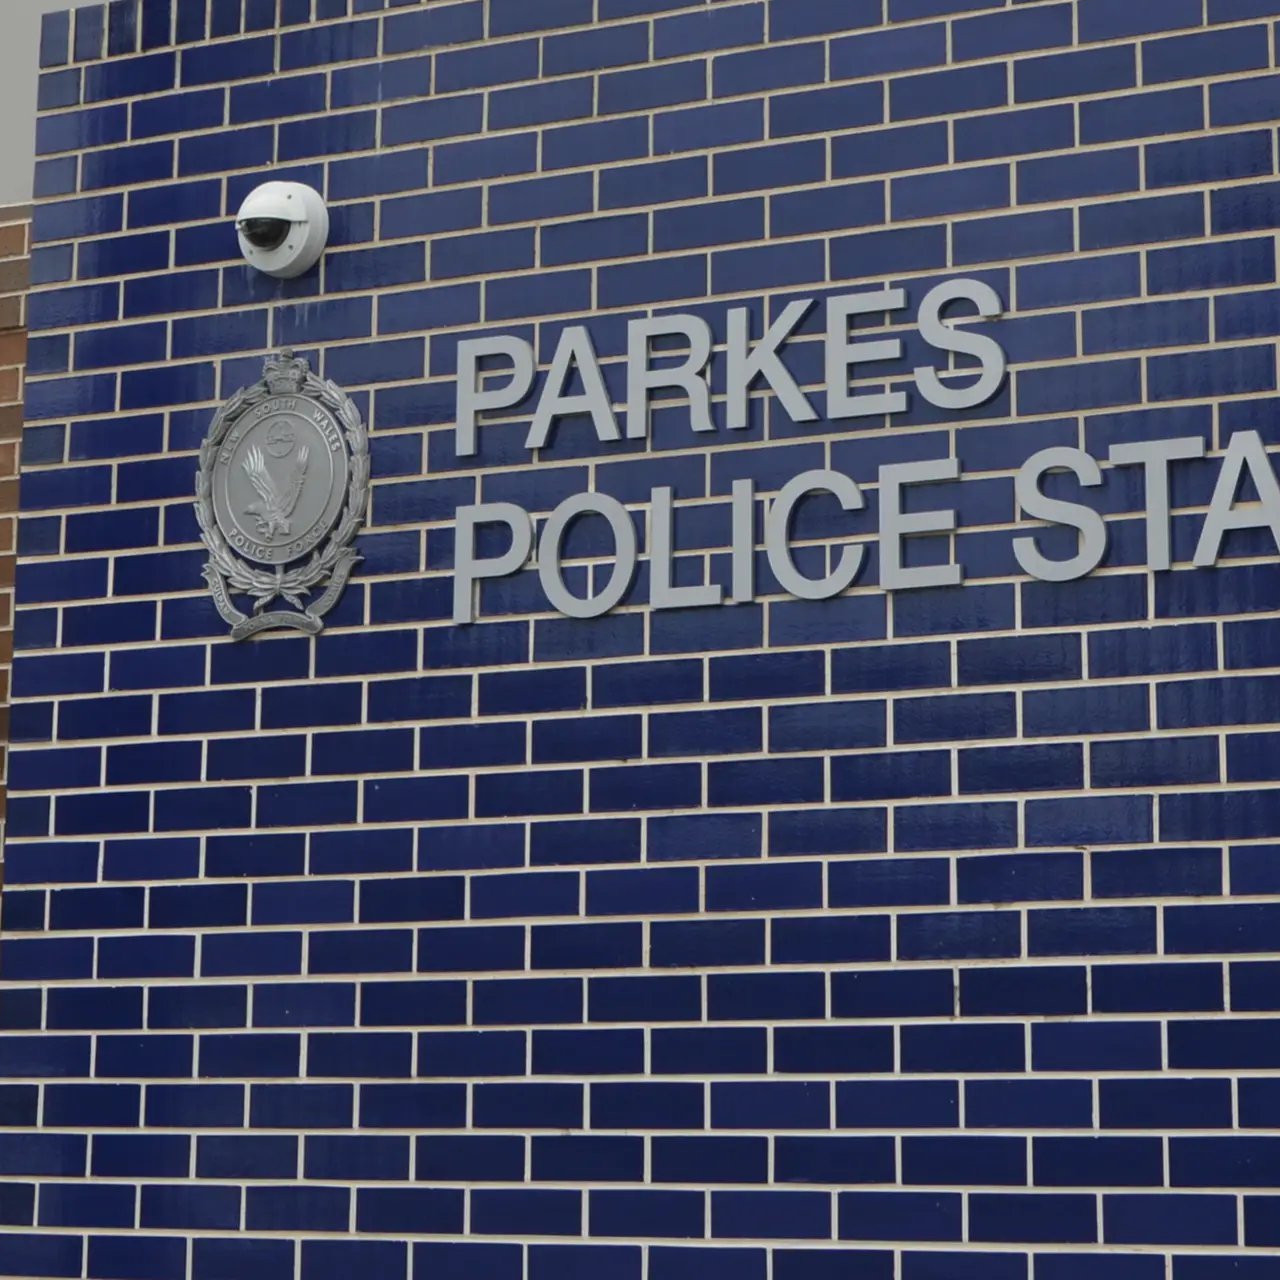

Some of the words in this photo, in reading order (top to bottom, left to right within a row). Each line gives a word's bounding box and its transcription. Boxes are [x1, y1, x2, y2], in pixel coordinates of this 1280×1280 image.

[455, 278, 1008, 457] PARKES
[219, 430, 240, 465] NEW
[253, 399, 298, 419] SOUTH
[312, 409, 342, 452] WALES
[228, 528, 273, 560] POLICE
[286, 519, 329, 558] FORCE
[453, 457, 963, 625] POLICE
